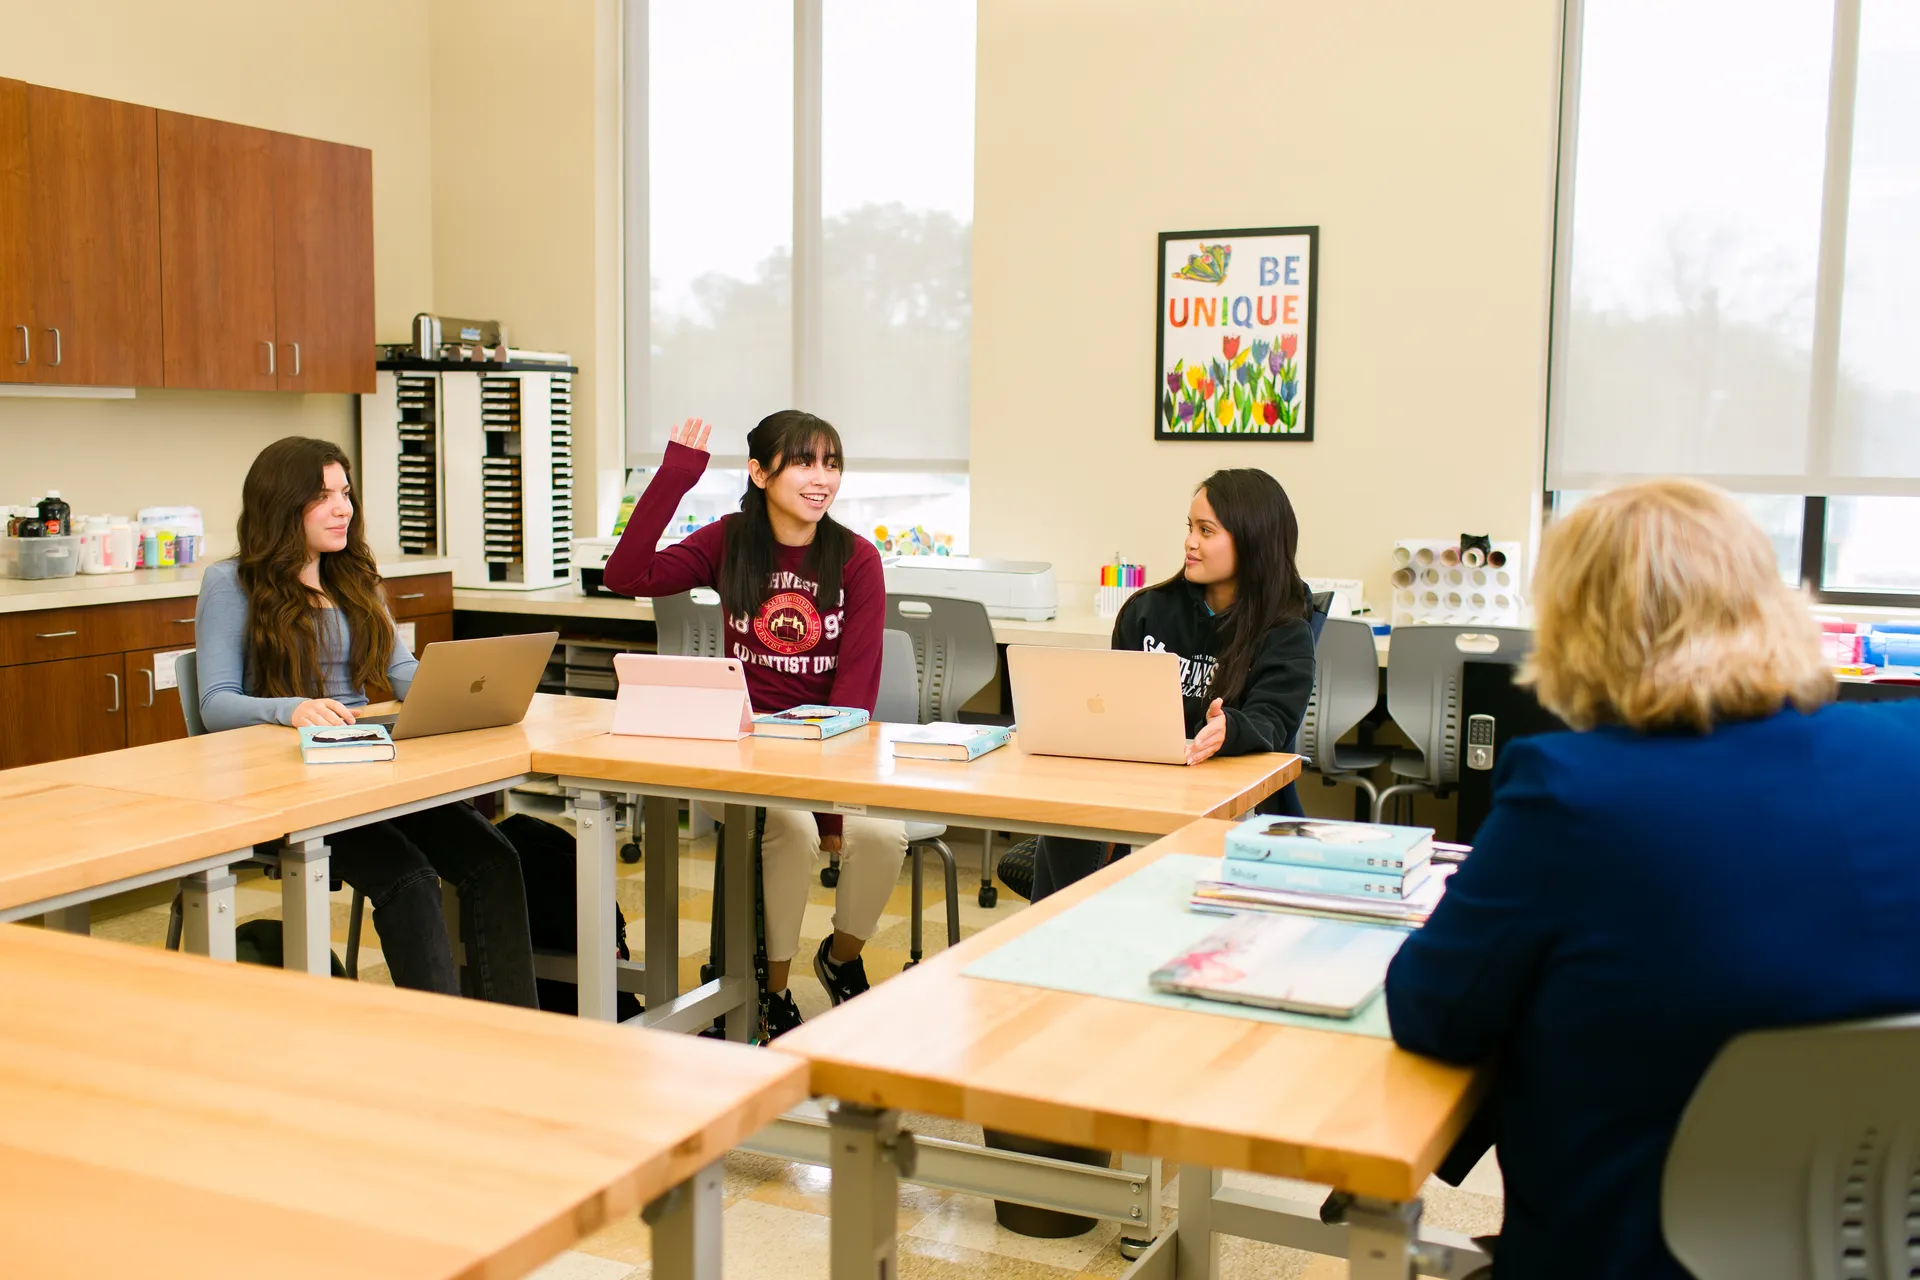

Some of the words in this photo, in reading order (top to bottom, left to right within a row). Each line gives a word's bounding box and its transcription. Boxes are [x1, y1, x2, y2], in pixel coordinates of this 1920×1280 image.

[1259, 256, 1300, 286] BE
[1169, 295, 1299, 329] UNIQUE
[765, 596, 814, 614] SOUTHWESTERN
[733, 642, 810, 674] ADVENTIST
